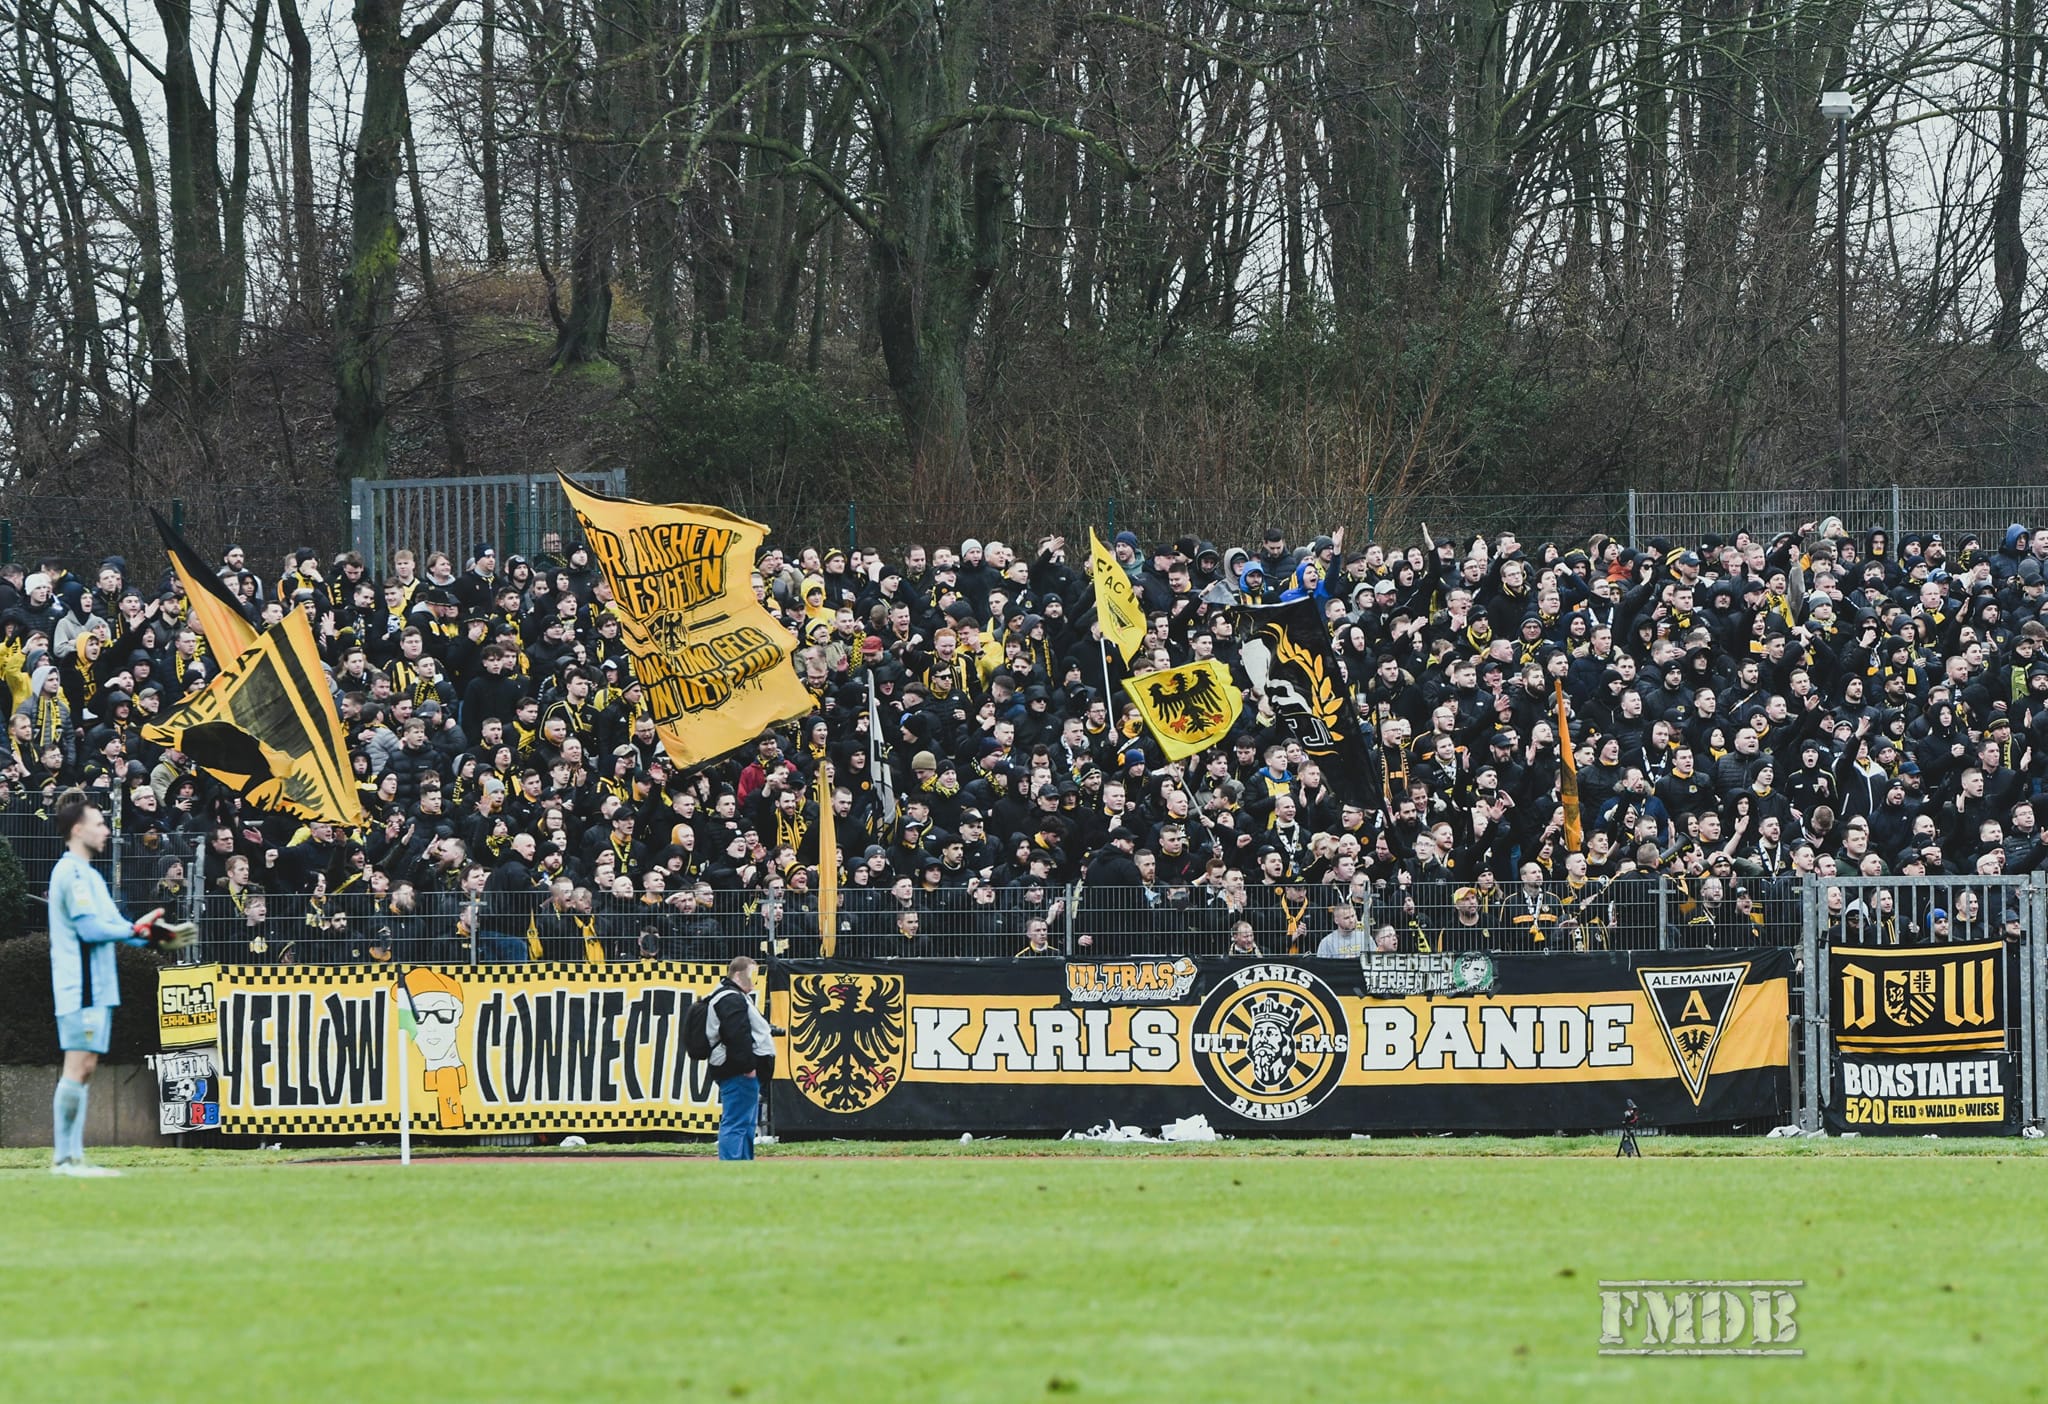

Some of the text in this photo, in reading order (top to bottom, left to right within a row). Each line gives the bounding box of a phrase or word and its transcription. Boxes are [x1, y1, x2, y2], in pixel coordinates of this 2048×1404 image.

[630, 525, 731, 574] AACHEN
[663, 558, 724, 610] GEBEN
[650, 679, 680, 720] IN
[678, 668, 728, 709] DEN
[1360, 953, 1453, 971] LEGENDEN
[1067, 963, 1175, 992] ULTRAS
[1232, 964, 1315, 990] KARLS
[1651, 971, 1737, 987] ALEMANNIA
[161, 1012, 217, 1027] ERHALTEN!
[181, 1003, 217, 1015] REGEL
[1680, 989, 1712, 1023] A
[219, 989, 757, 1106] YELLOW CONNECTI
[911, 1007, 1181, 1072] KARLS
[1361, 1004, 1634, 1071] BANDE
[163, 1054, 210, 1078] NEIN
[1843, 1060, 2004, 1097] BOXSTAFFEL
[163, 1101, 187, 1125] ZU
[1230, 1096, 1313, 1121] BANDE
[1845, 1098, 1886, 1124] 520
[1892, 1105, 1916, 1118] FELD
[1925, 1104, 1956, 1118] WALD
[1964, 1102, 2000, 1117] WIESE
